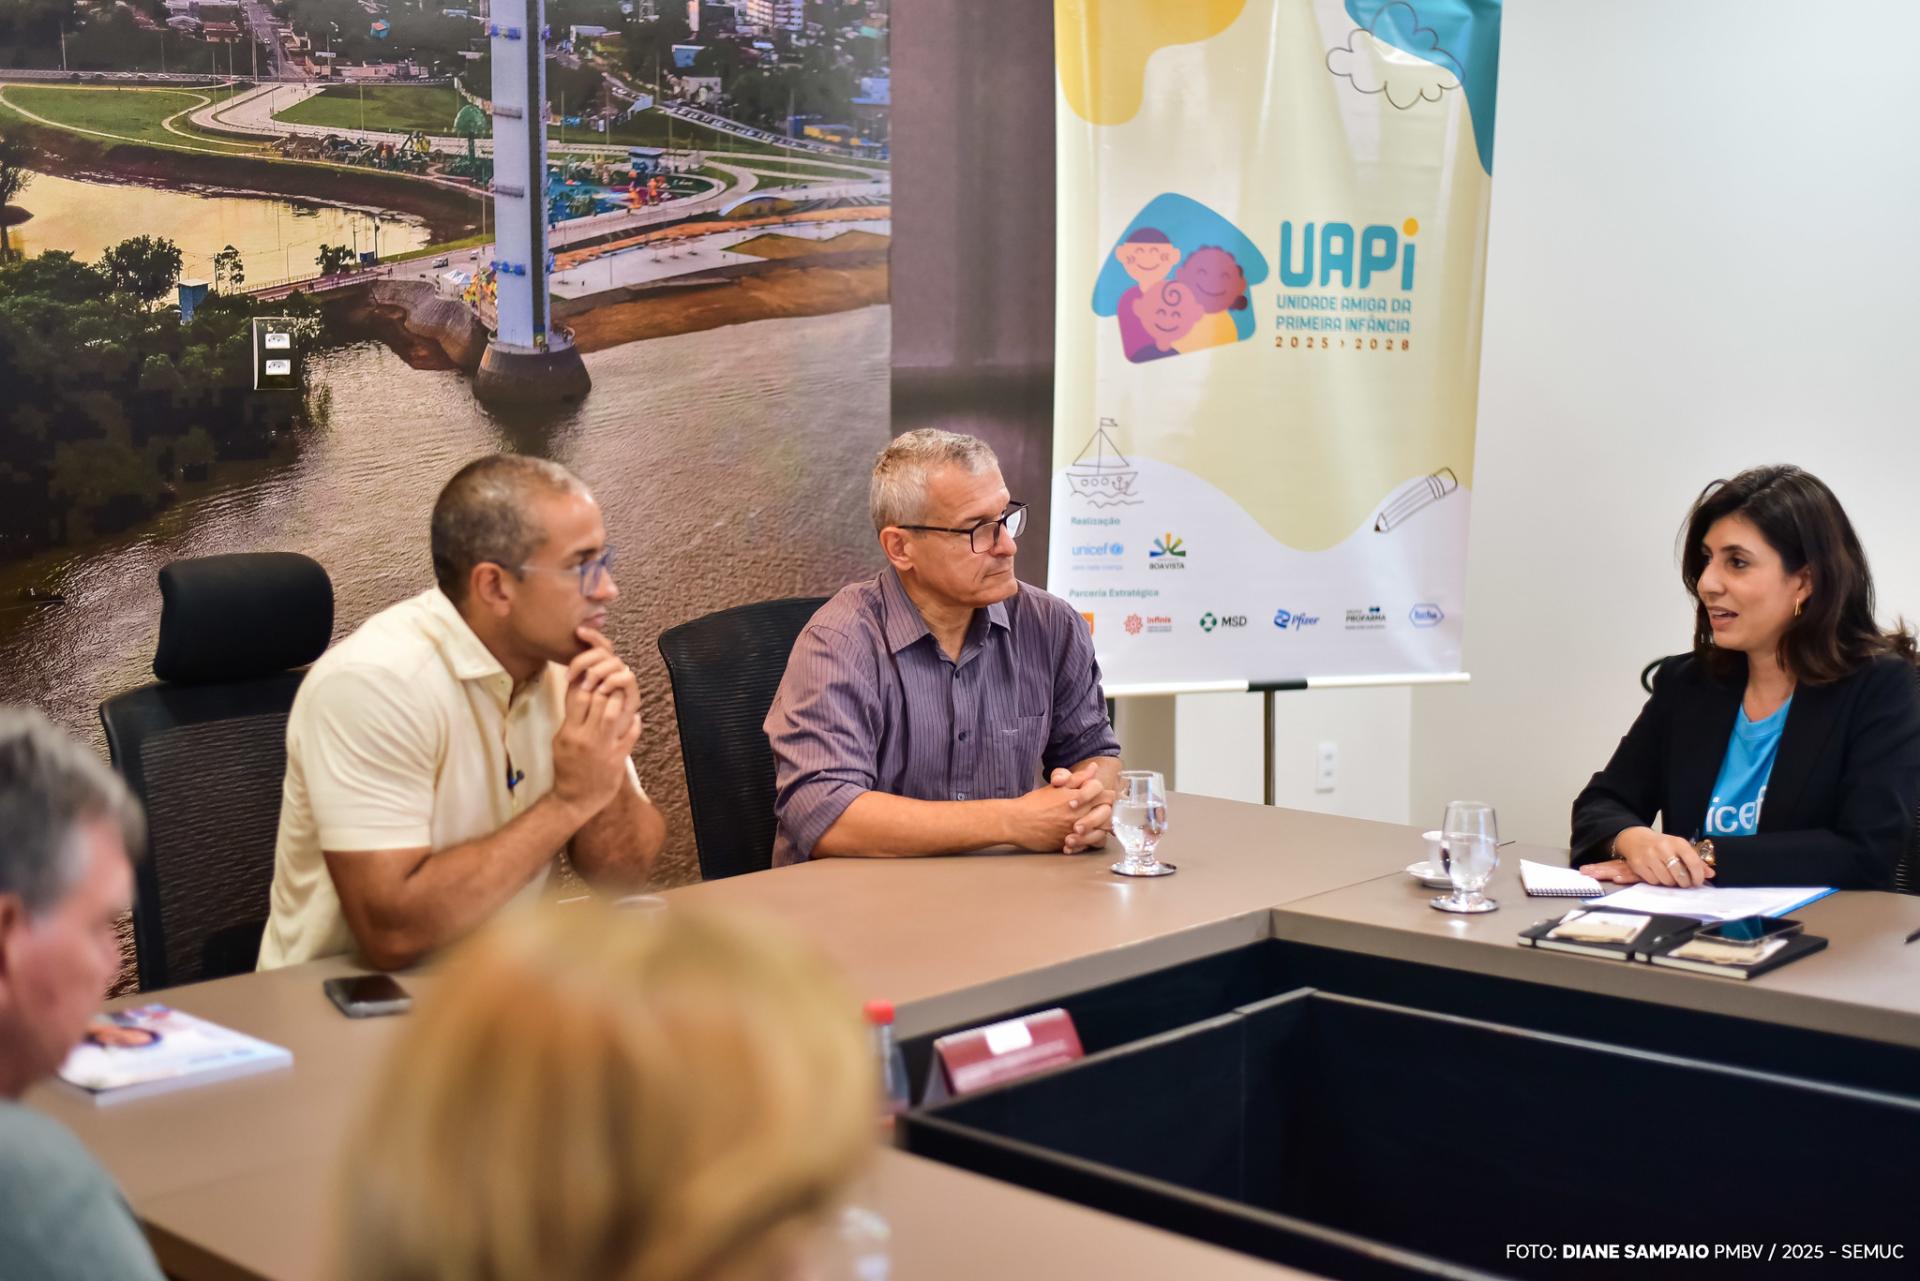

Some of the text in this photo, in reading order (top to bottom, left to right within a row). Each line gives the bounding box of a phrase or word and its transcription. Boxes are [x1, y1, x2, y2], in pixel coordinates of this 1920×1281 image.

[1276, 294, 1412, 314] UNIDADE AMIGA DA
[1275, 314, 1410, 333] PRIMEIRA INFÂNCIA
[1275, 336, 1329, 349] 2025
[1355, 338, 1409, 351] 2028
[1071, 516, 1121, 527] Realização
[1072, 542, 1108, 556] unicef
[1164, 562, 1185, 570] VISTA
[1069, 588, 1107, 598] Parceria
[1221, 616, 1247, 627] MSD
[1291, 613, 1320, 631] Pfizer
[1345, 614, 1386, 622] PROFARMA
[1706, 785, 1767, 832] icef
